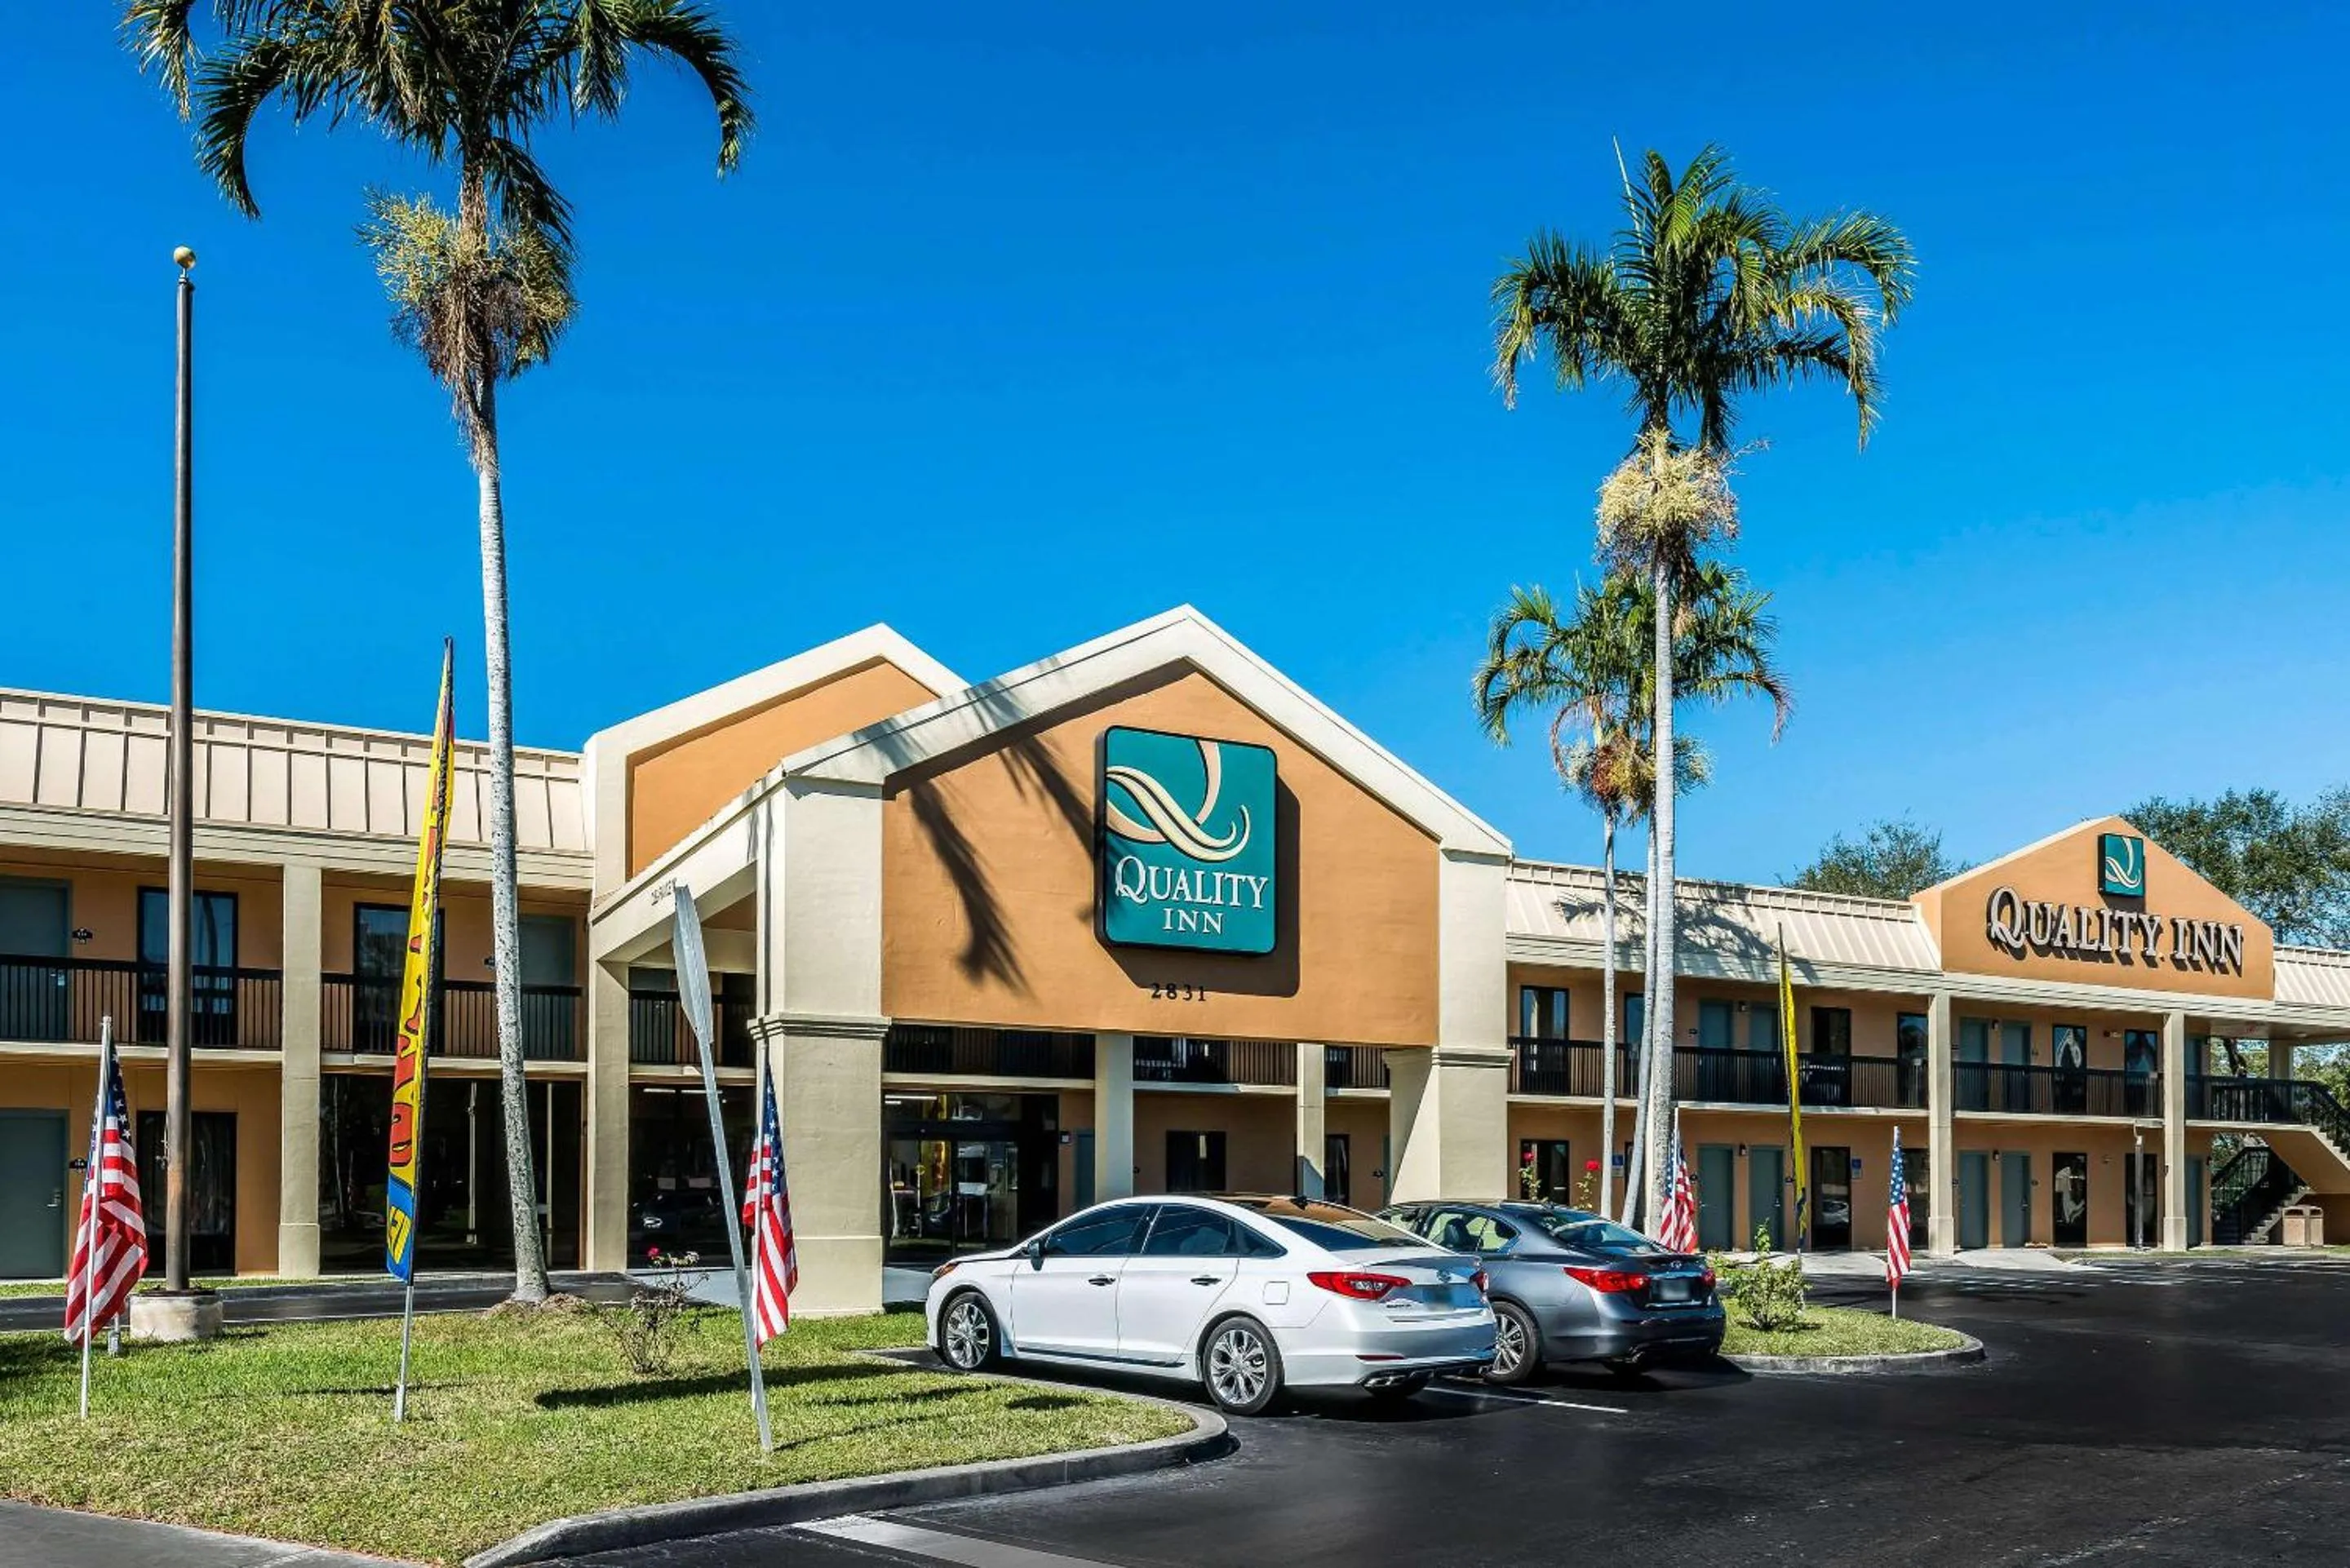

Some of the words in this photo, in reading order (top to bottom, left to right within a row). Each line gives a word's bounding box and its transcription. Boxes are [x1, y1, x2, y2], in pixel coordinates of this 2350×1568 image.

[1115, 855, 1268, 909] QUALITY
[1162, 907, 1224, 934] INN
[1986, 886, 2162, 957] QUALITY
[2170, 917, 2243, 967] INN
[1151, 981, 1207, 1002] 2831
